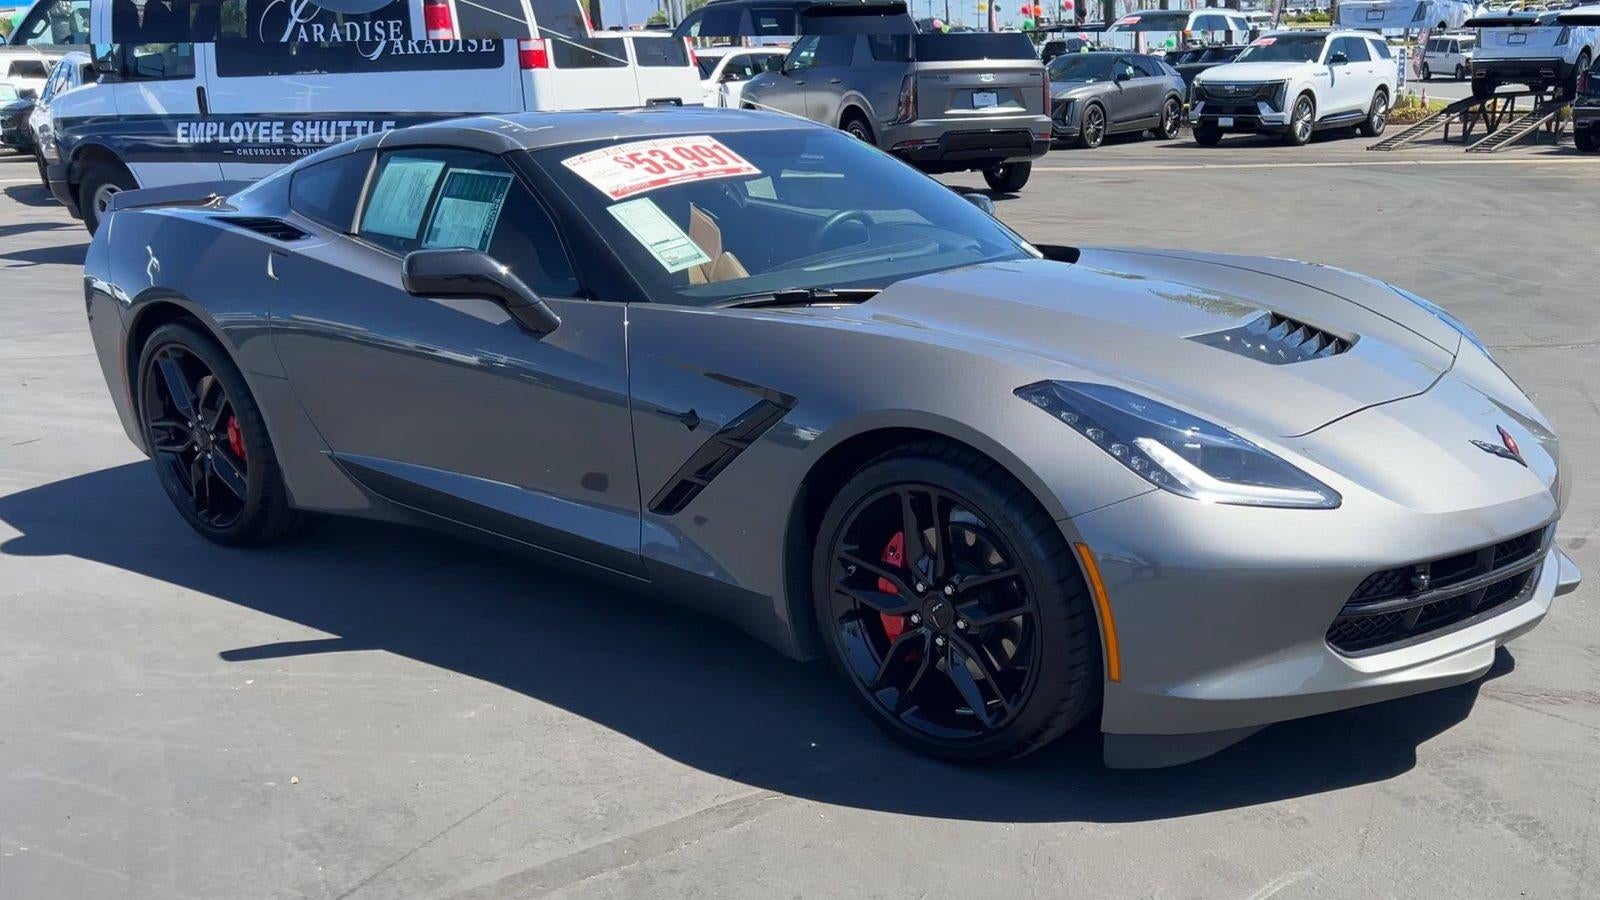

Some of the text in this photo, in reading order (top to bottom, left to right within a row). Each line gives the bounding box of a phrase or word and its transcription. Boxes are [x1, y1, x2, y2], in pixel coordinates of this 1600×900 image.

[356, 38, 497, 60] ARADISE
[176, 122, 284, 143] EMPLOYEE
[236, 148, 286, 156] CHEVROLET
